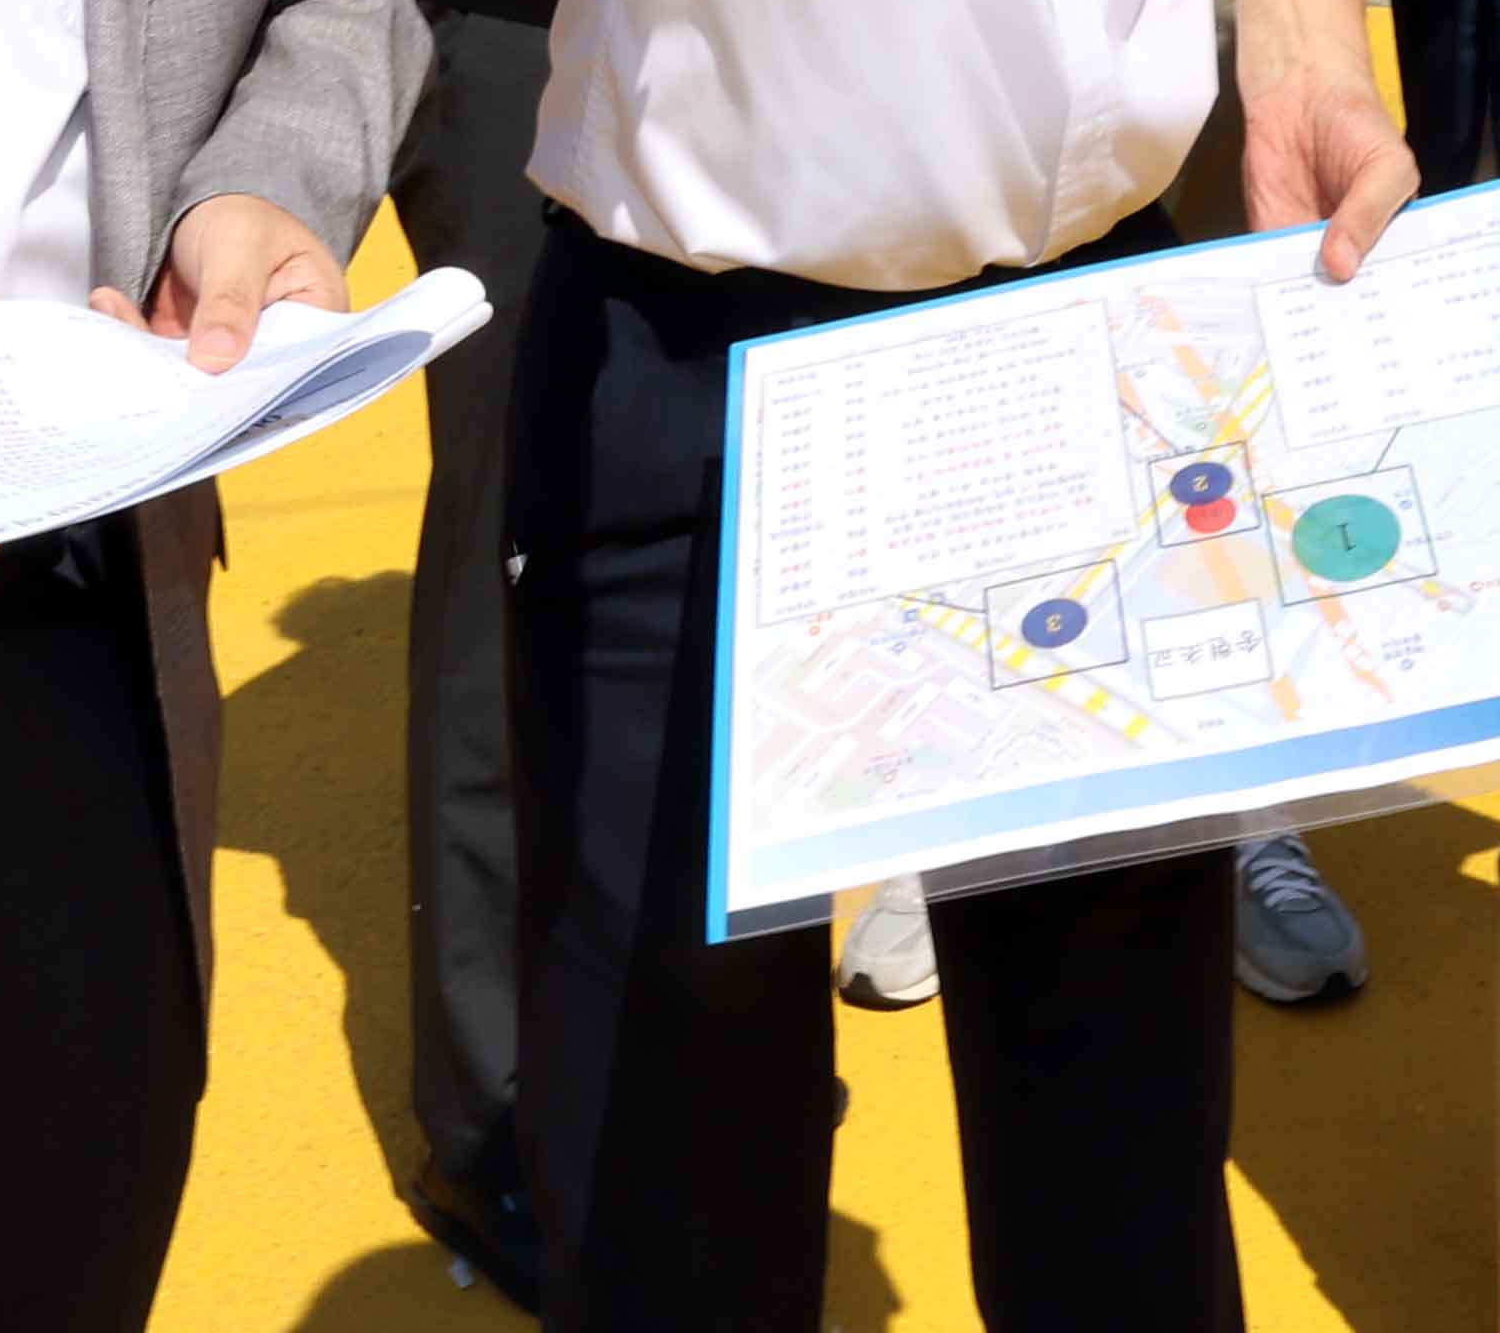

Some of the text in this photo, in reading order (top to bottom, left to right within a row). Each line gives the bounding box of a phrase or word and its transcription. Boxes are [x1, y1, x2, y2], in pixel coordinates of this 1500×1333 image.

[1191, 475, 1209, 493] 2
[1338, 522, 1357, 552] 1
[1046, 613, 1063, 633] 3
[1153, 630, 1262, 668] 송현초교
